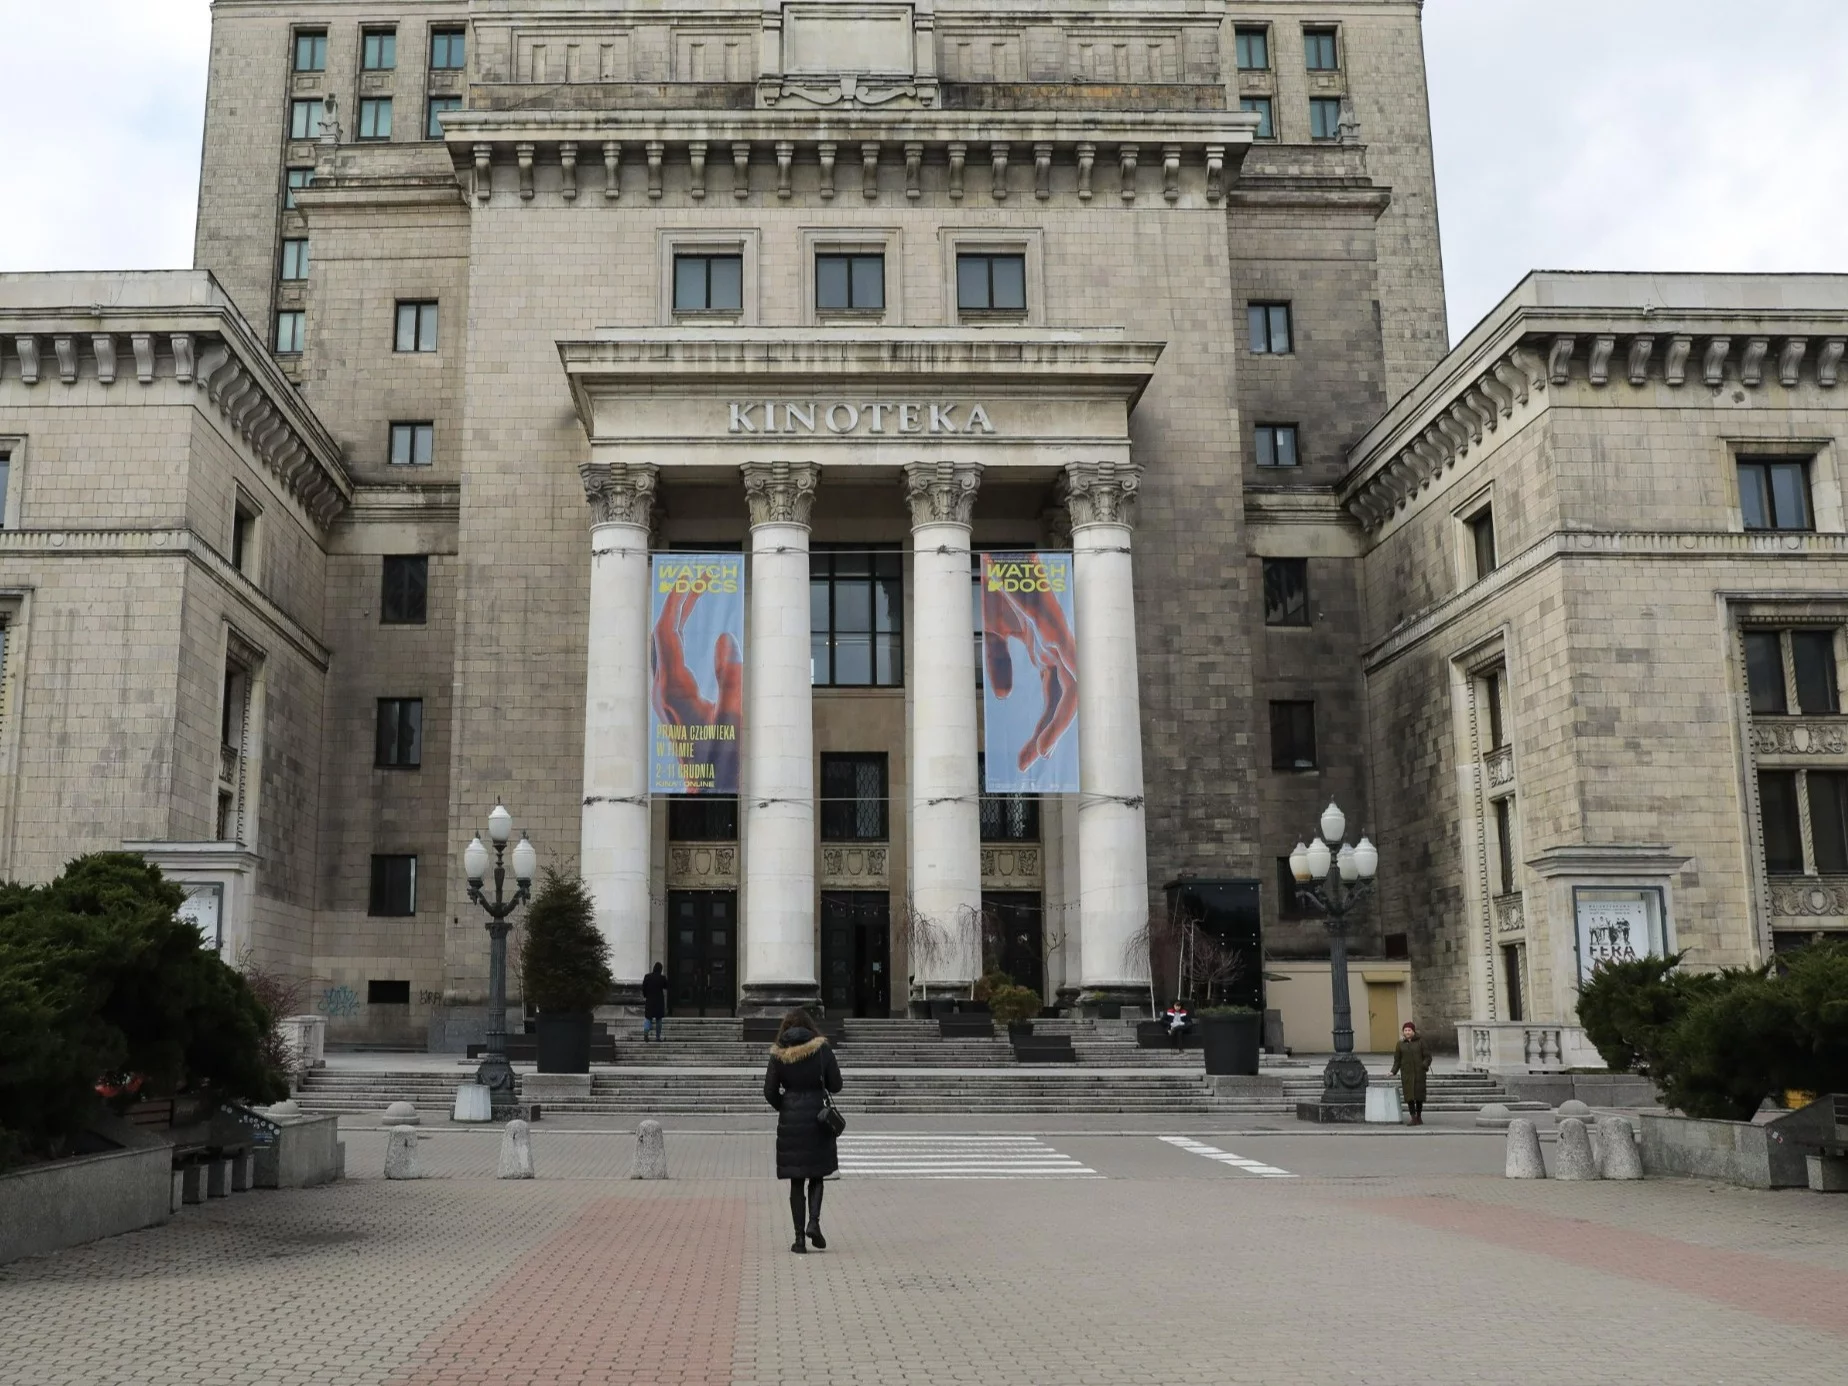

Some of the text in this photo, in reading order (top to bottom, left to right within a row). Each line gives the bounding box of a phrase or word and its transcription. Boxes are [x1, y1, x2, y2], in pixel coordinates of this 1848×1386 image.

[727, 401, 997, 434] KINOTEKA
[659, 565, 738, 579] WATCH
[987, 564, 1066, 578] WATCH
[676, 579, 738, 594] DOCS
[1004, 578, 1066, 593] DOCS
[656, 724, 735, 740] PRAWA CZŁOWIEKA
[656, 741, 665, 757] W
[678, 763, 715, 779] GRUDNIA
